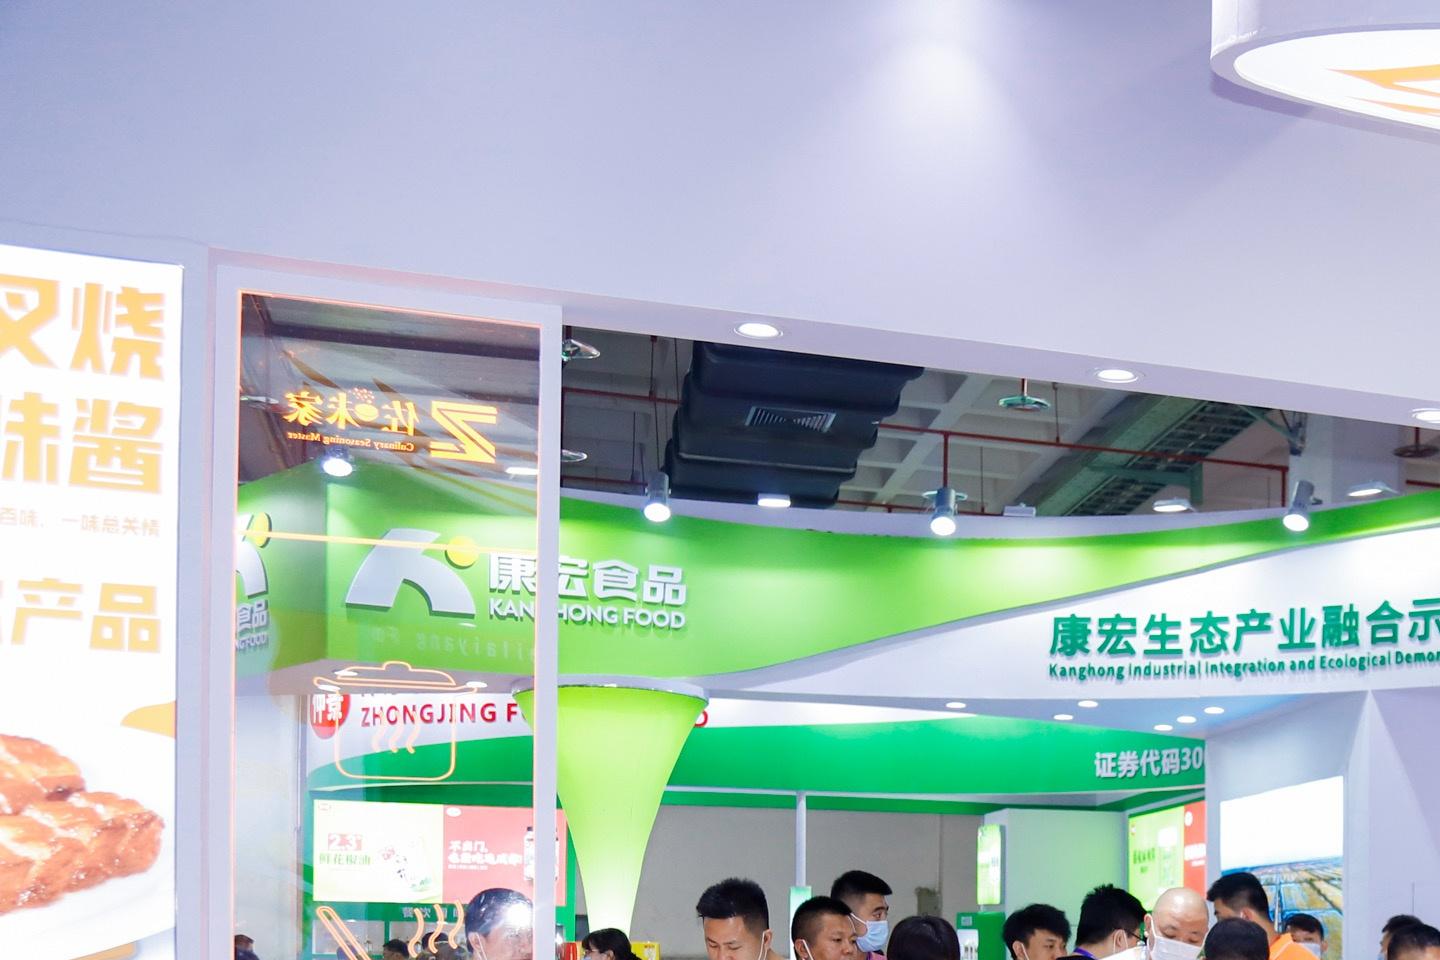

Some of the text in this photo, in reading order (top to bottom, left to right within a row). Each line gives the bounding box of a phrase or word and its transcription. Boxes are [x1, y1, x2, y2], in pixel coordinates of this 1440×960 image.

[489, 553, 687, 605] 康宏食品
[0, 577, 162, 654] 产品
[489, 597, 686, 629] KANHONG FOOD
[1049, 662, 1125, 681] Kanghong
[1128, 660, 1201, 678] Industrial
[1205, 657, 1285, 678] Integration
[1289, 655, 1315, 671] and
[1319, 650, 1391, 671] Ecological
[361, 702, 496, 728] ZHONGJING
[1094, 747, 1205, 779] 证券代码30
